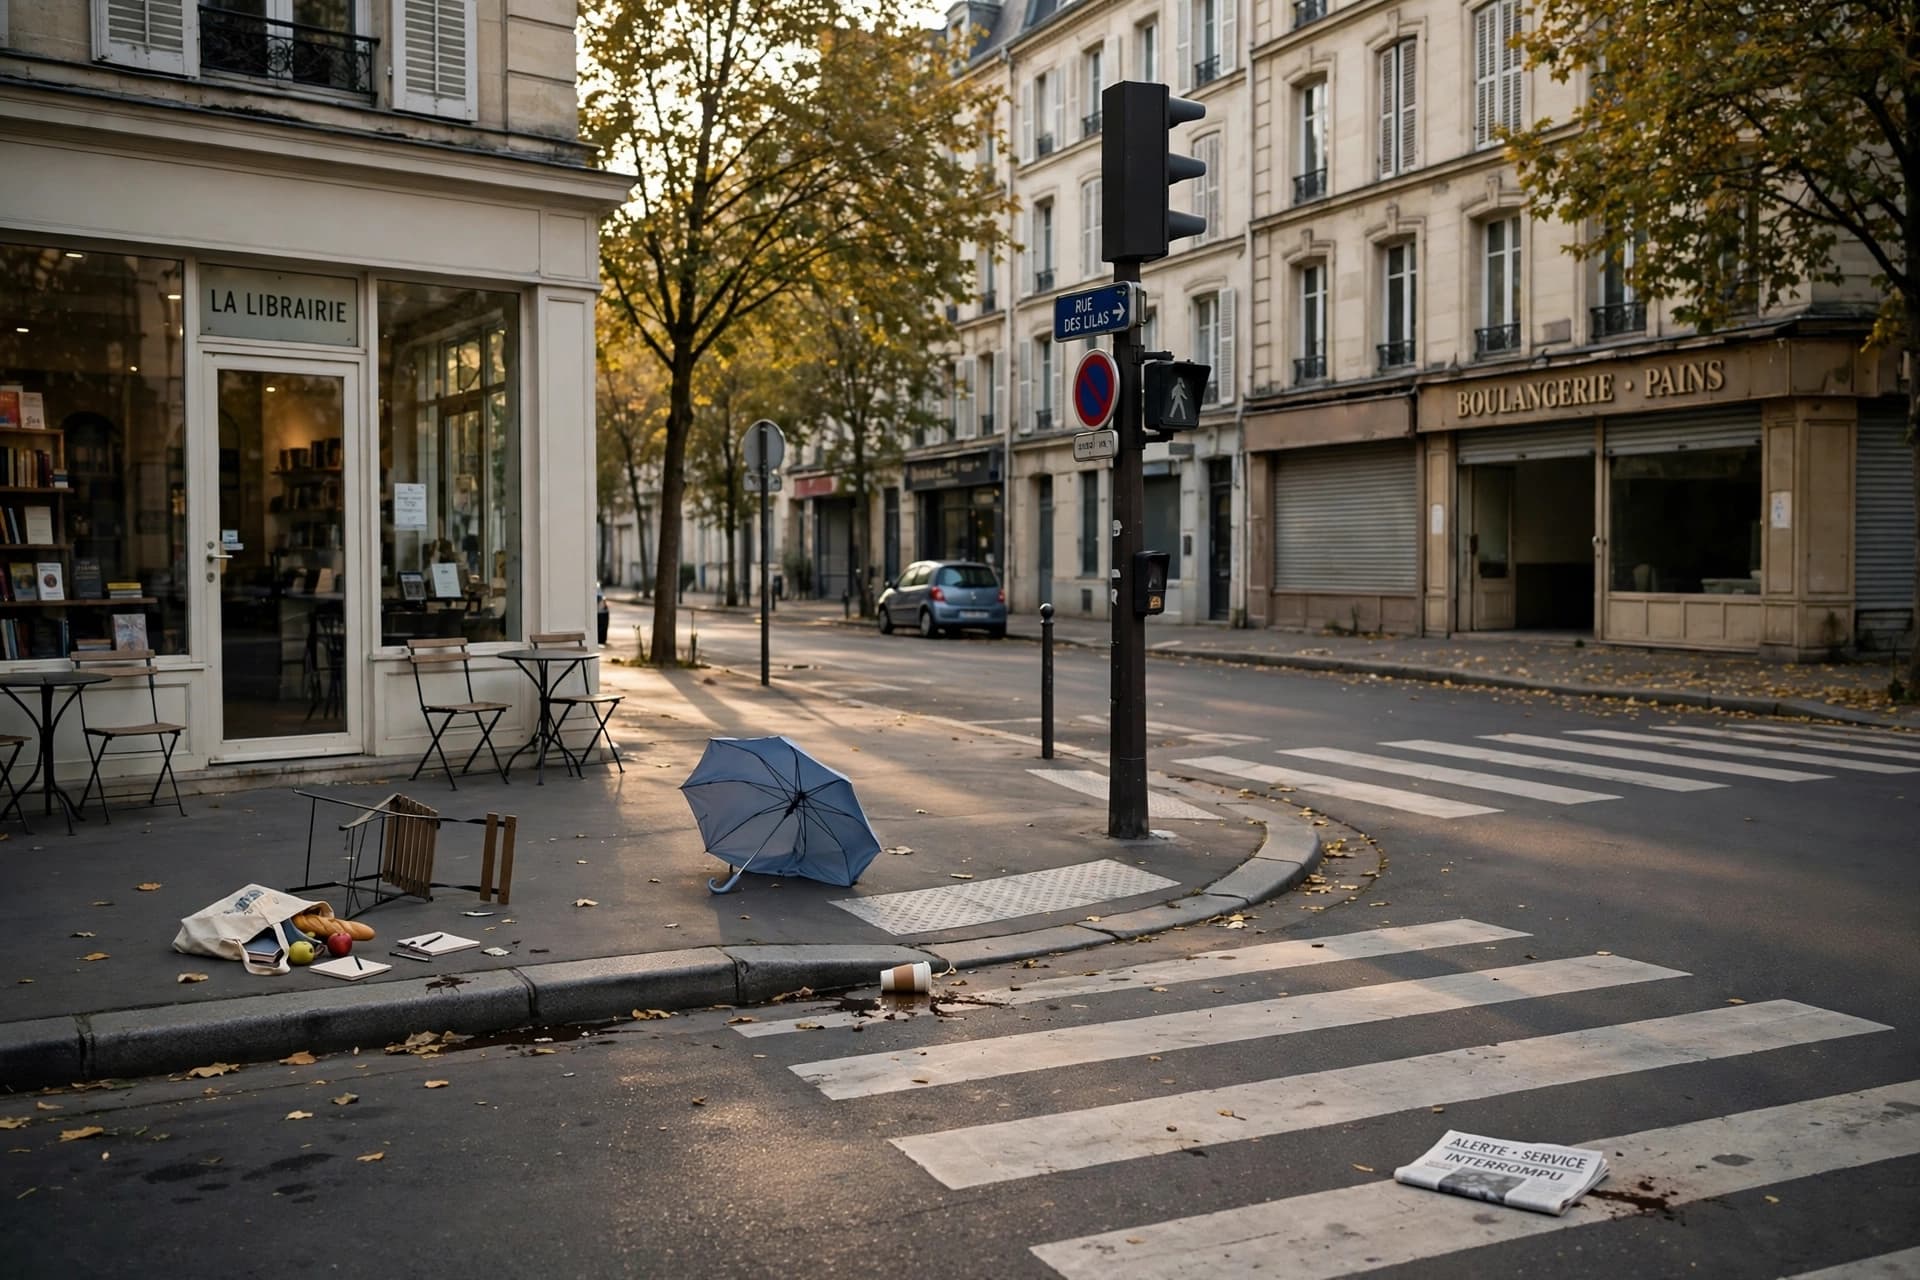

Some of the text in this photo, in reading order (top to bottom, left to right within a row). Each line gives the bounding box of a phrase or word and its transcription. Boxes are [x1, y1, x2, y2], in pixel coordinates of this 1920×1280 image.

[211, 289, 347, 323] LA LIBRAIRIE
[1075, 296, 1093, 314] RUE
[1064, 312, 1110, 333] DES LILAS
[1456, 359, 1725, 418] BOULANGERIE PAINS
[1445, 1153, 1564, 1181] INTERROMPU
[1450, 1137, 1587, 1169] ALERTE SERVICE
